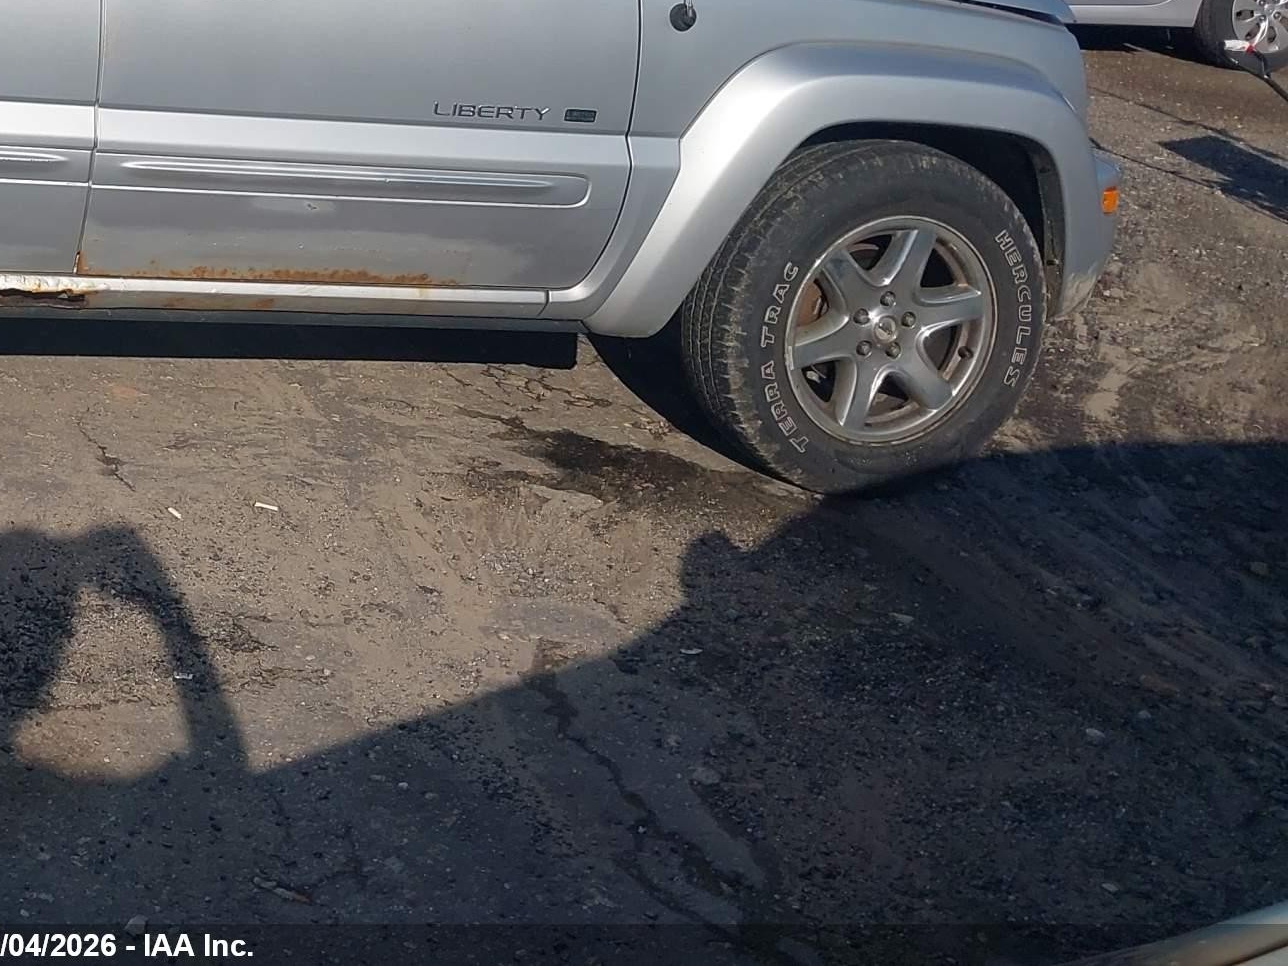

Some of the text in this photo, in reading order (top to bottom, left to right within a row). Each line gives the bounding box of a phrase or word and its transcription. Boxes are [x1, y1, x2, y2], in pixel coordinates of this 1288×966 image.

[432, 101, 551, 121] LIBERTY
[761, 262, 809, 453] TERRA TRAC
[995, 229, 1032, 387] HERCULES
